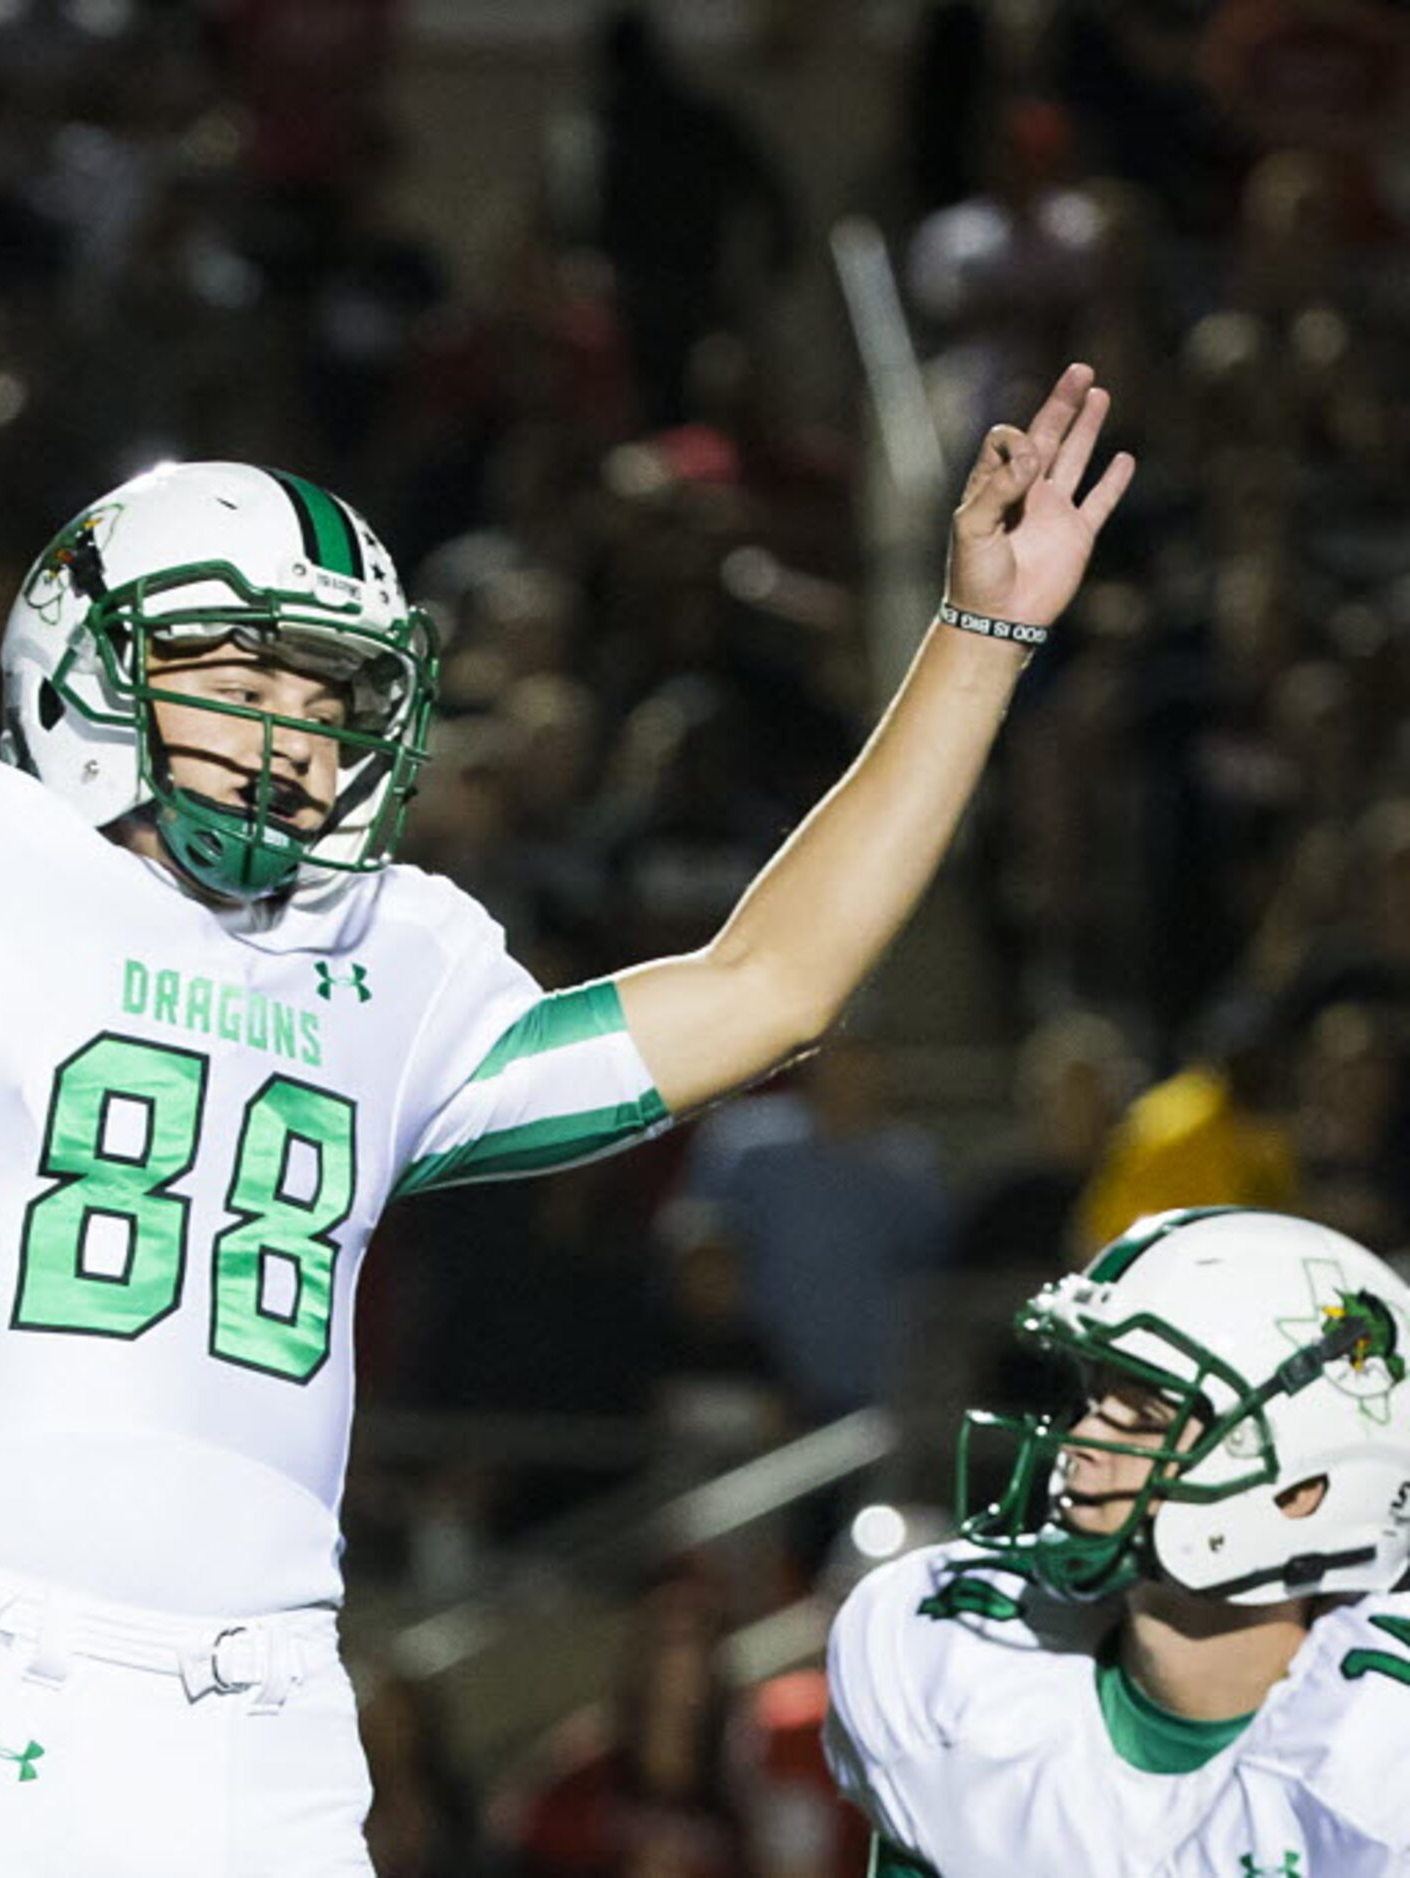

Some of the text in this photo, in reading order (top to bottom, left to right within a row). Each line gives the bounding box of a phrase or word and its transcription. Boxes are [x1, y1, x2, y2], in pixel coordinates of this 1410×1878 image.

[961, 613, 990, 635] BIG
[993, 621, 1010, 638] IS
[1012, 624, 1047, 643] GOD
[120, 957, 324, 1068] DRAGONS
[8, 1029, 358, 1387] 88
